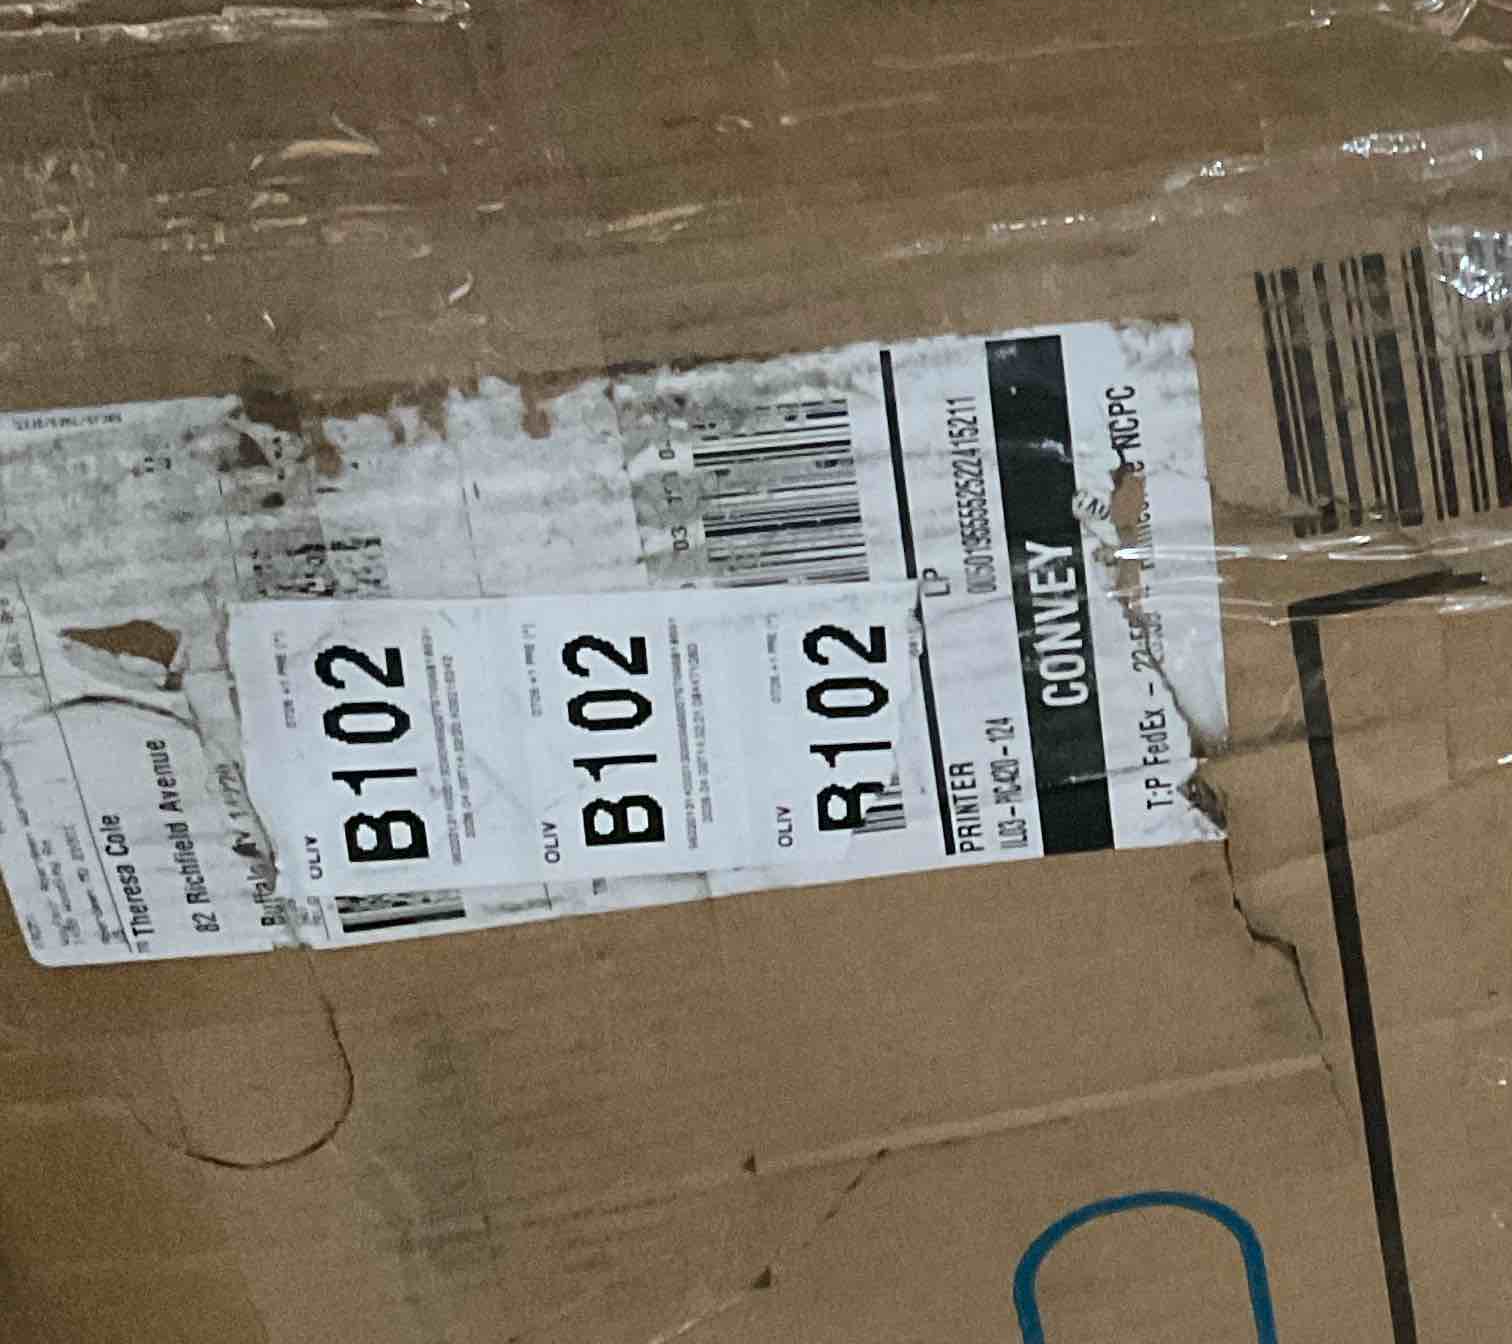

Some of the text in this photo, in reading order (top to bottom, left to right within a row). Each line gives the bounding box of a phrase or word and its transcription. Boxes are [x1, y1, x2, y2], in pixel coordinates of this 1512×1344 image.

[1106, 385, 1142, 451] NCPC
[922, 567, 952, 597] LP
[1025, 540, 1089, 707] CONVEY
[314, 644, 429, 863] B102
[562, 635, 665, 847] B102
[1138, 707, 1170, 767] FedEx
[145, 738, 221, 933] 82 Richfield Avenue
[542, 821, 560, 864] OLIV
[776, 806, 793, 848] OLIV
[948, 760, 985, 853] PRINTER
[99, 814, 155, 936] Theresa Cole
[304, 834, 322, 880] OLIV
